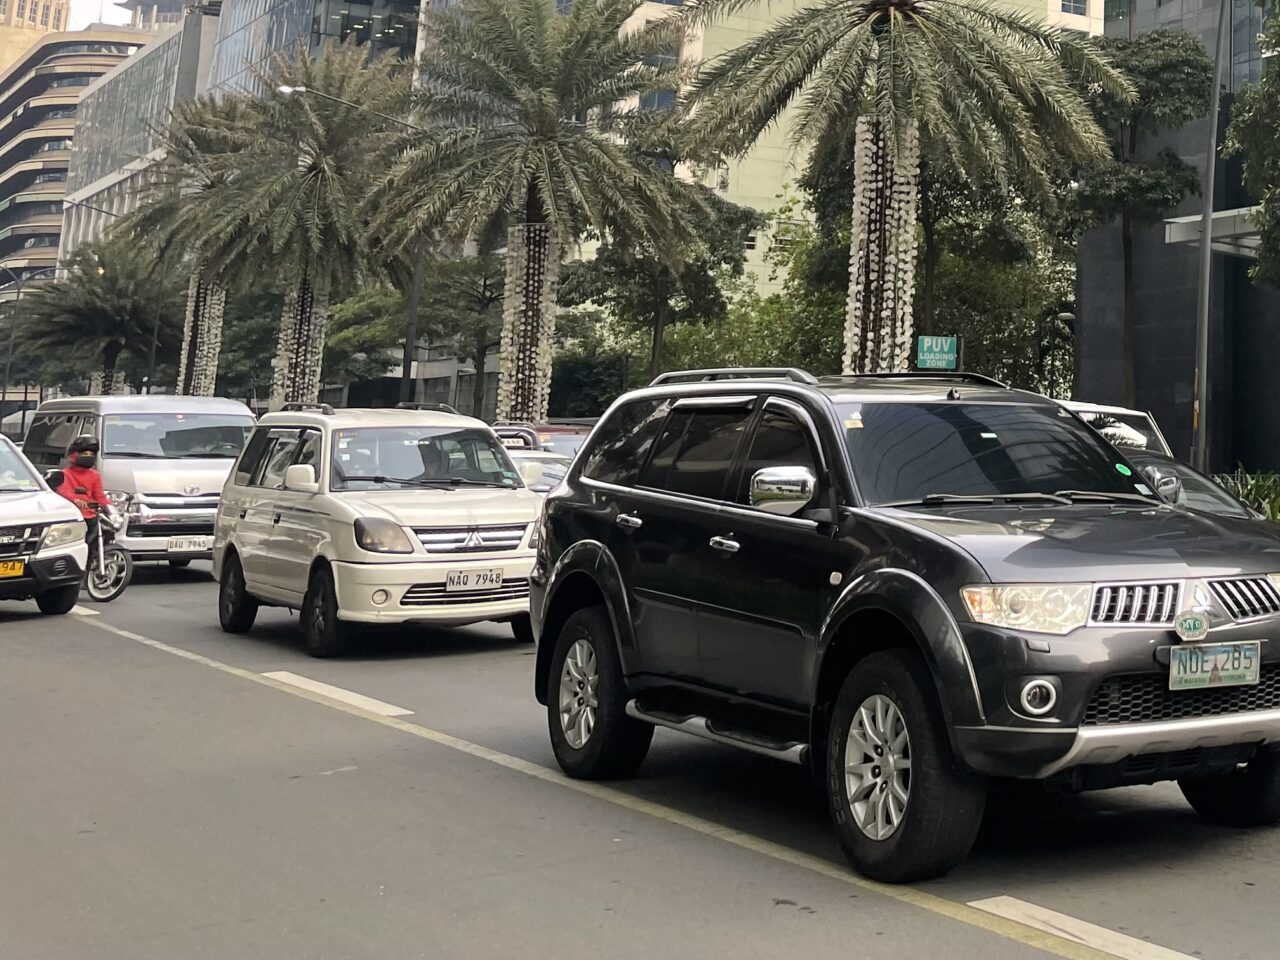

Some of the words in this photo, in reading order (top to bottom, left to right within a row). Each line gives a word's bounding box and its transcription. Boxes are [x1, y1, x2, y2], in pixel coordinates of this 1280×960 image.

[923, 338, 951, 352] PUV
[919, 352, 954, 361] LOADING
[448, 574, 469, 587] NAQ
[475, 573, 501, 585] 7948
[1220, 647, 1253, 671] 285
